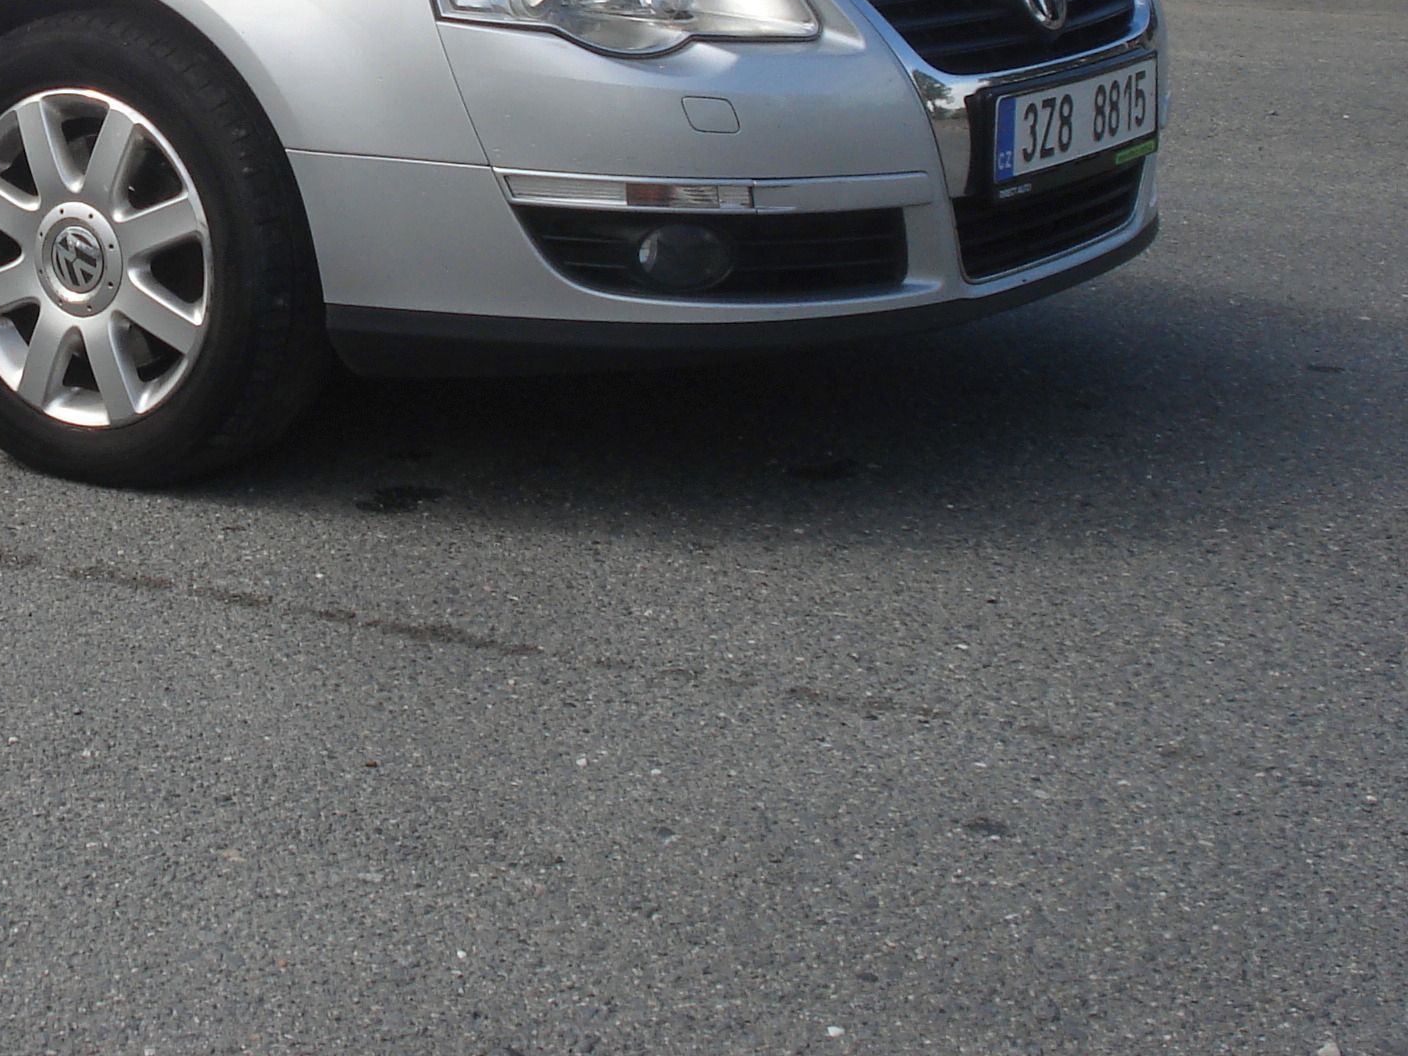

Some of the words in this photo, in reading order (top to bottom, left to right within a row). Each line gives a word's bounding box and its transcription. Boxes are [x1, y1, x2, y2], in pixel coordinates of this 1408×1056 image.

[1022, 94, 1074, 162] 3Z8
[1093, 70, 1146, 142] 8815
[998, 151, 1013, 170] CZ
